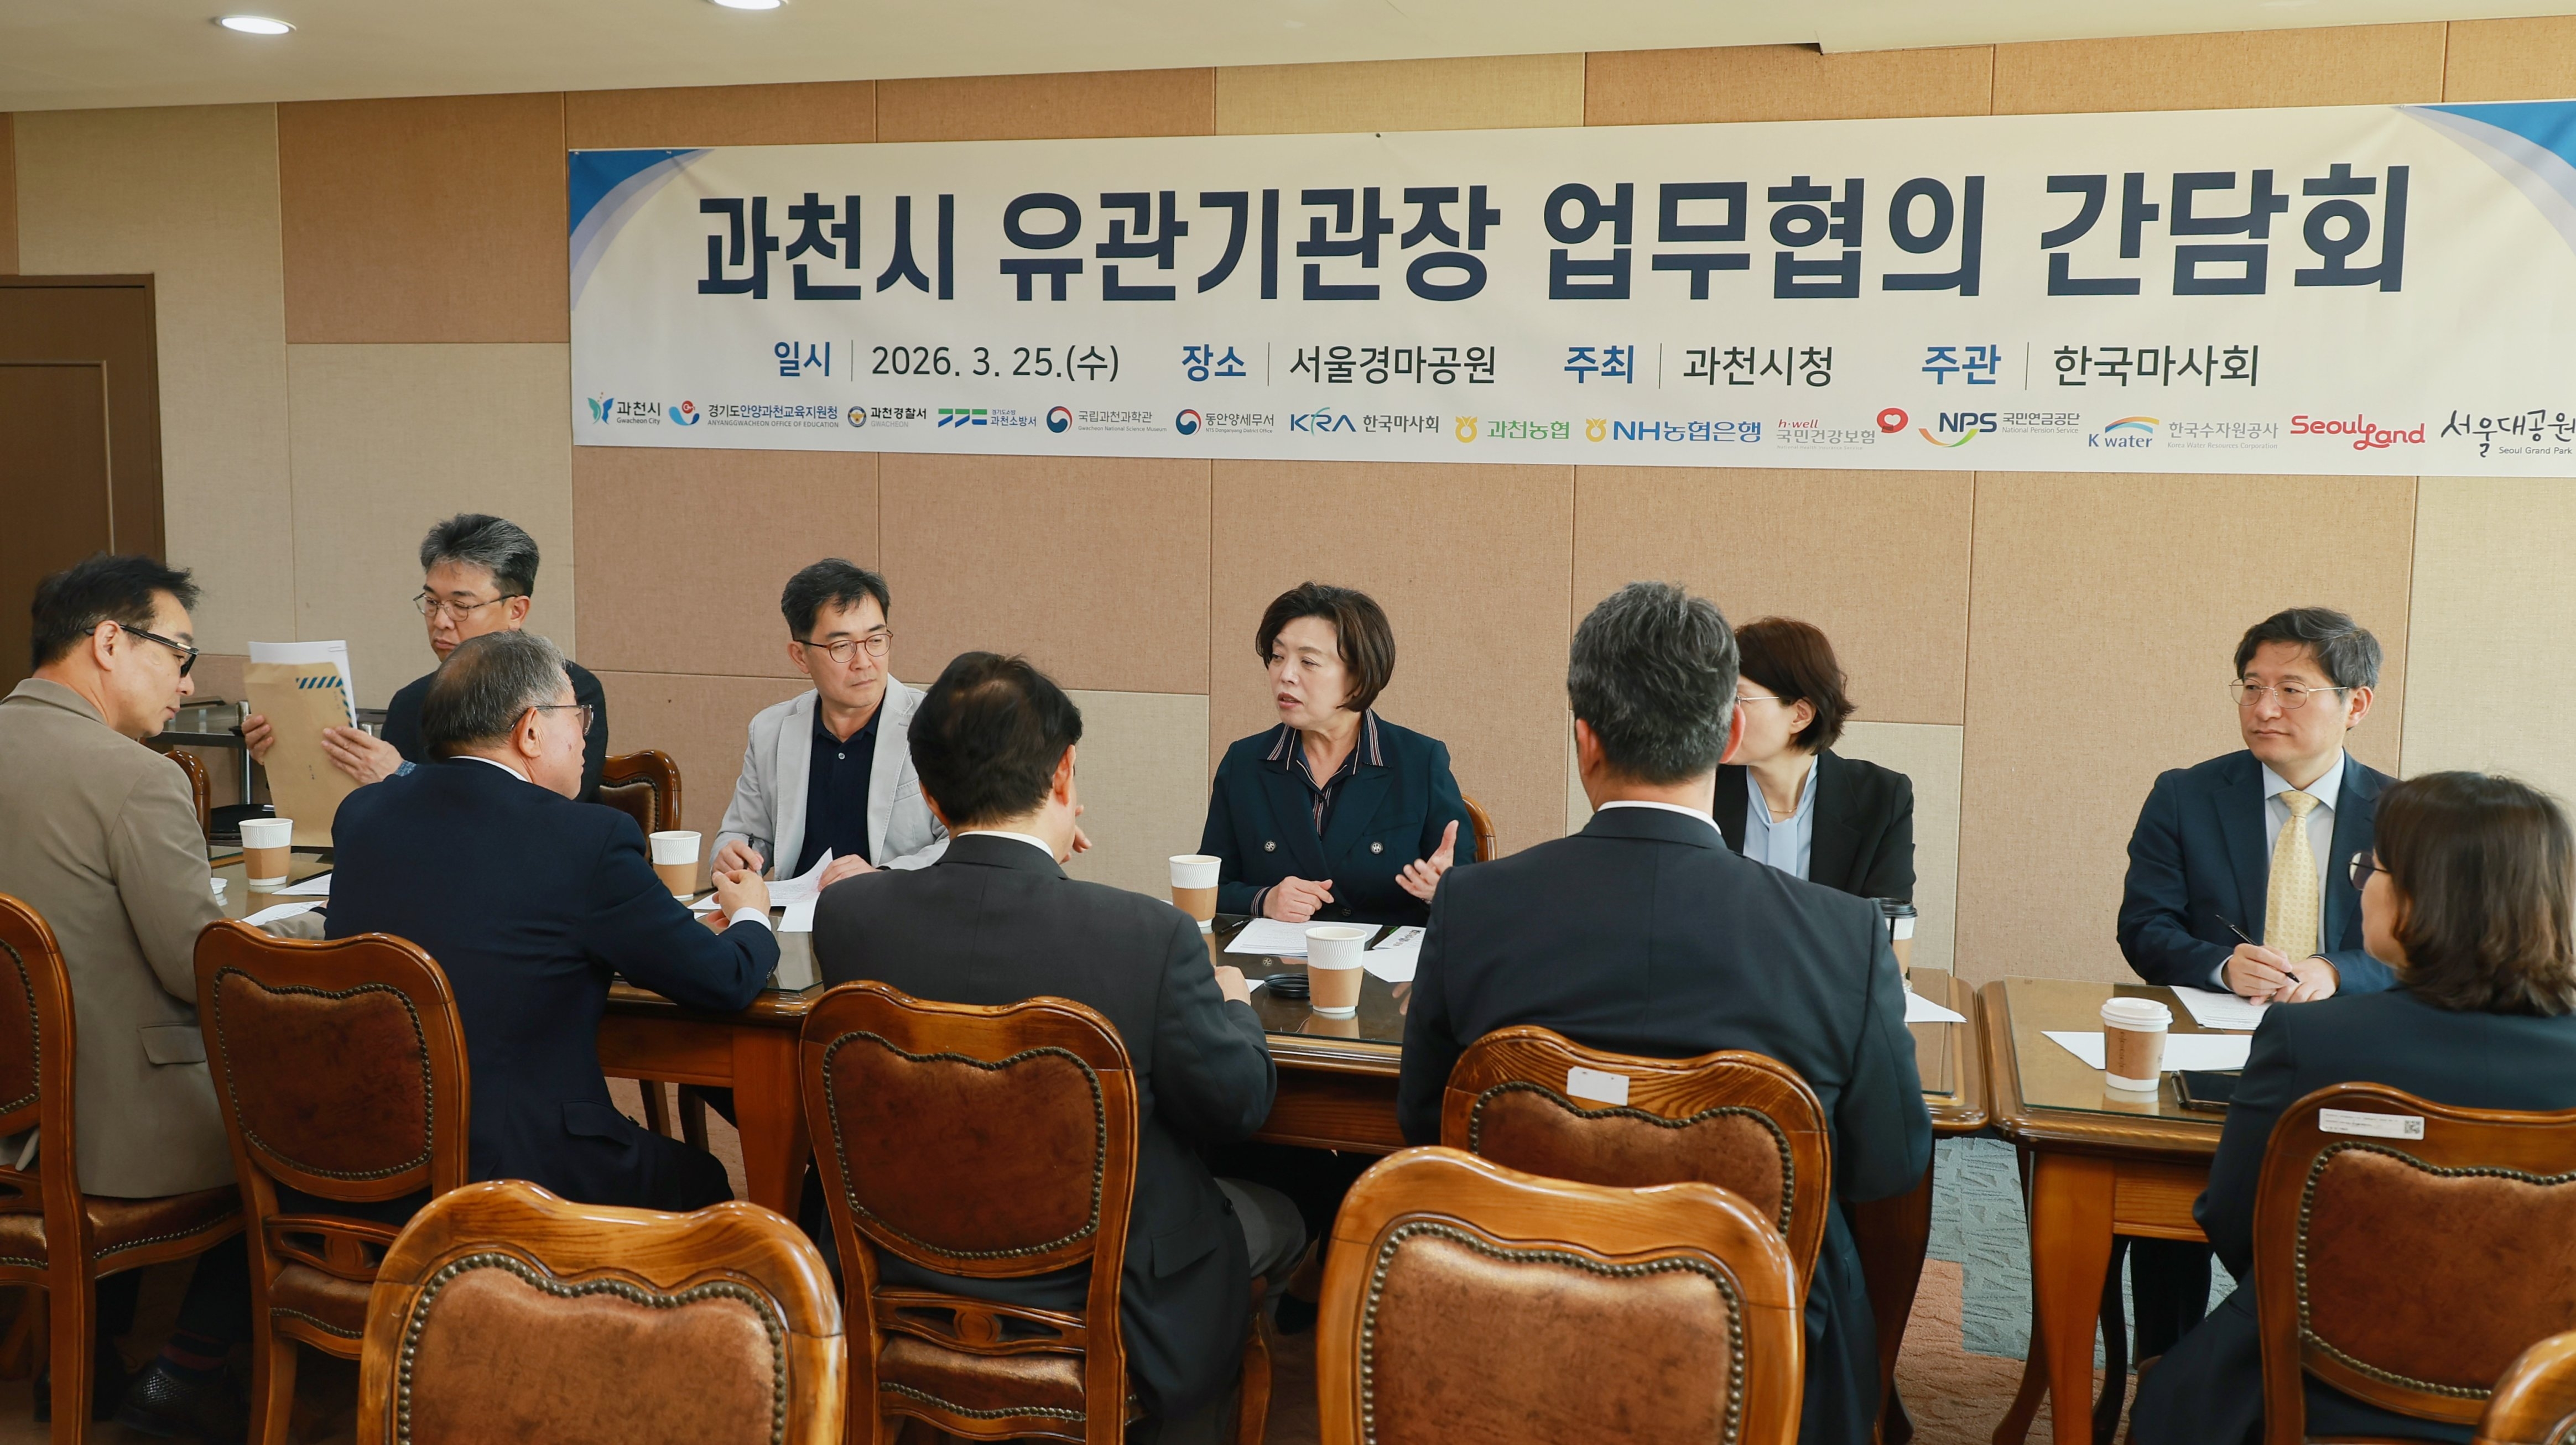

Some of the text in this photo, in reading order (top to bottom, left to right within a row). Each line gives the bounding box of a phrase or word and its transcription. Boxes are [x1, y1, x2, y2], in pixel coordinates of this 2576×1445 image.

[698, 164, 2409, 301] 과천시 유관기관장 업무협의 간담회
[774, 342, 1118, 382] 일시 2026. 3. 25.(수)
[1182, 344, 1494, 384] 장소 서울경마공원
[1564, 345, 1831, 387] 주최 과천시청
[1922, 345, 2258, 387] 주관 한국마사회
[617, 401, 660, 416] 과천시
[709, 404, 837, 419] 경기도안양과천교육지원청
[871, 408, 926, 419] 과천경찰서
[1079, 411, 1152, 422] 국립과천과학관
[991, 416, 1036, 426] 과천소방서
[1205, 414, 1273, 426] 동안양세무서
[1291, 409, 1356, 435] KRA
[1363, 415, 1439, 433] 한국마사회
[1939, 413, 1997, 432] NPS
[2003, 413, 2080, 425] 국민연금공단
[1487, 420, 1569, 440] 과천농협
[1614, 421, 1761, 442] NH농협은행
[1776, 430, 1875, 444] 국민건강보험
[2169, 422, 2278, 439] 한국수자원공사
[2291, 414, 2425, 450] Seoul Land
[2441, 409, 2575, 457] 서울대공원
[2089, 434, 2152, 447] K water
[2240, 442, 2278, 450] Corporation
[2525, 446, 2551, 455] Grand
